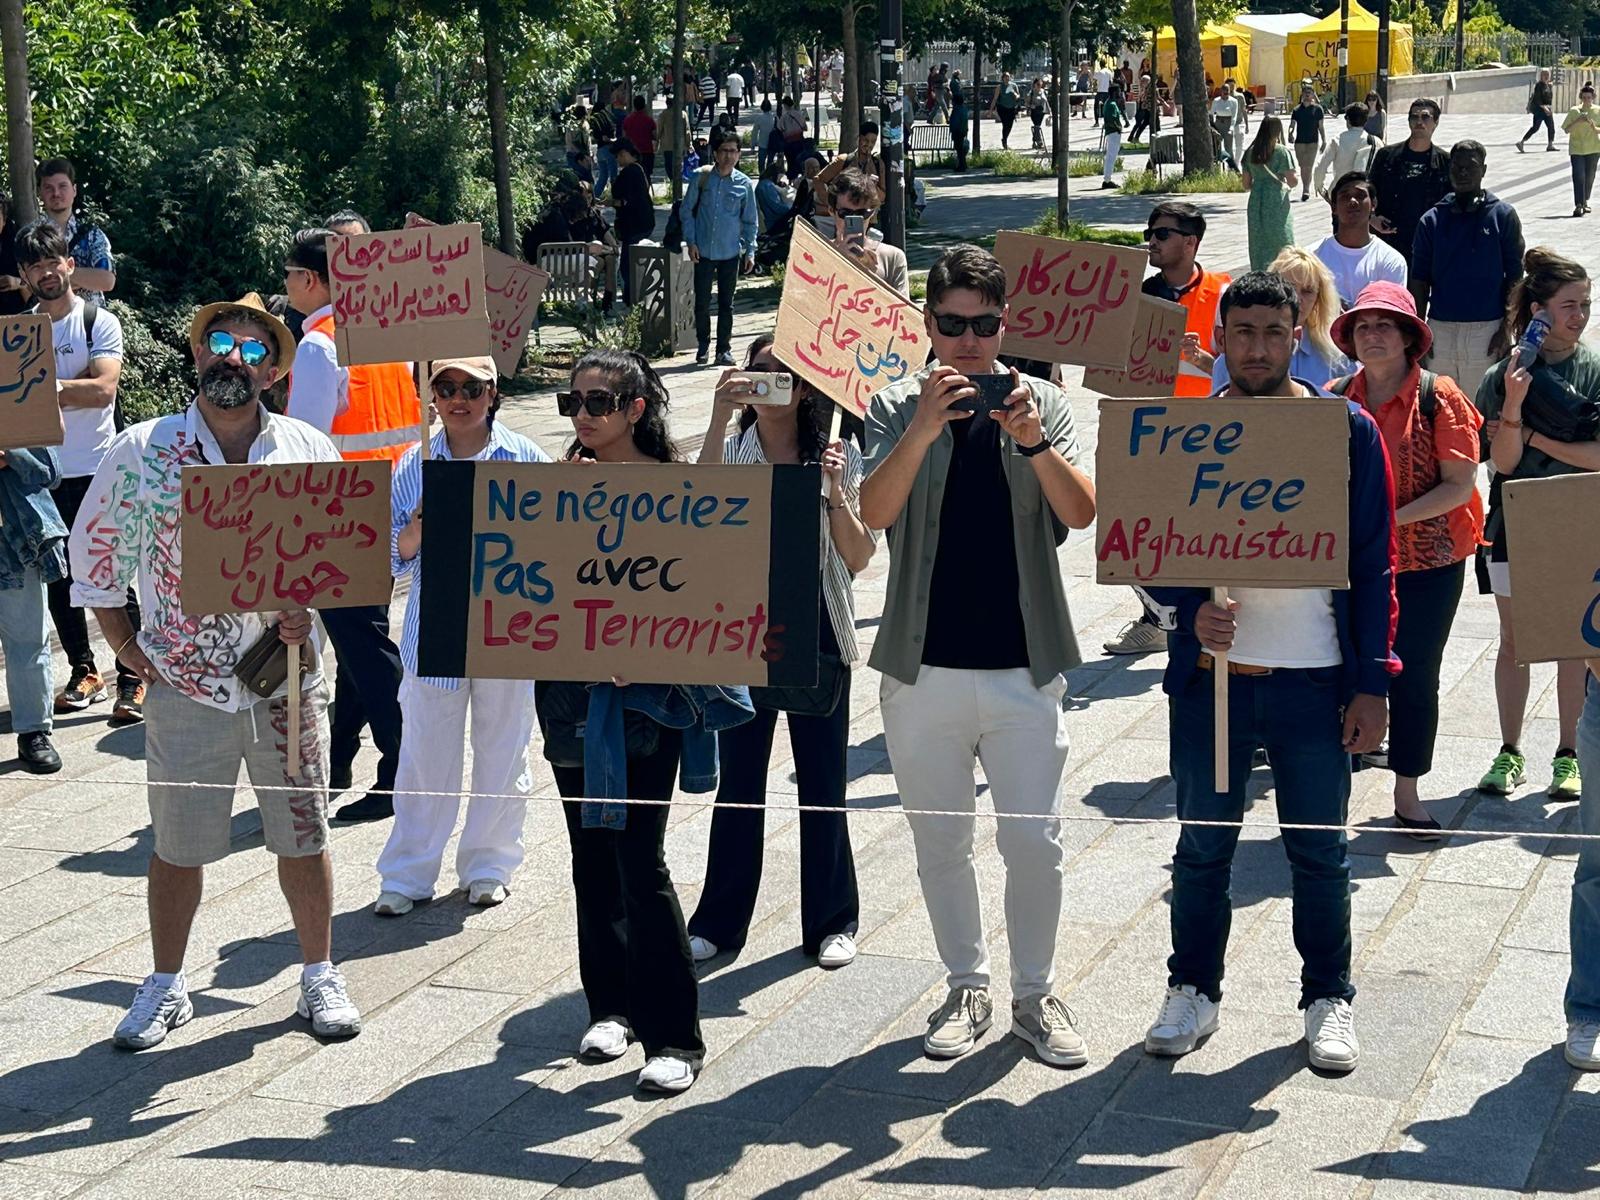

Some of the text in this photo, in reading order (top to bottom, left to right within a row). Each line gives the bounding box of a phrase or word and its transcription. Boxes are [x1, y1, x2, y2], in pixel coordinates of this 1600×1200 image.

[387, 233, 470, 275] سیاست
[1007, 247, 1073, 298] کار
[416, 277, 471, 317] لعنت
[792, 252, 919, 344] مذاکره محکوم است
[20, 323, 42, 358] از
[1007, 302, 1108, 347] آزادی
[795, 341, 854, 393] است
[856, 336, 908, 382] وطن
[1130, 406, 1244, 456] Free
[274, 463, 375, 506] طالبان
[1189, 462, 1305, 513] Free
[275, 498, 378, 562] دشمن
[488, 479, 750, 553] Ne négociez
[472, 532, 688, 604] Pas avec
[1098, 516, 1336, 581] Afghanistan
[231, 560, 350, 610] جهان
[483, 599, 786, 663] Les Terrorists
